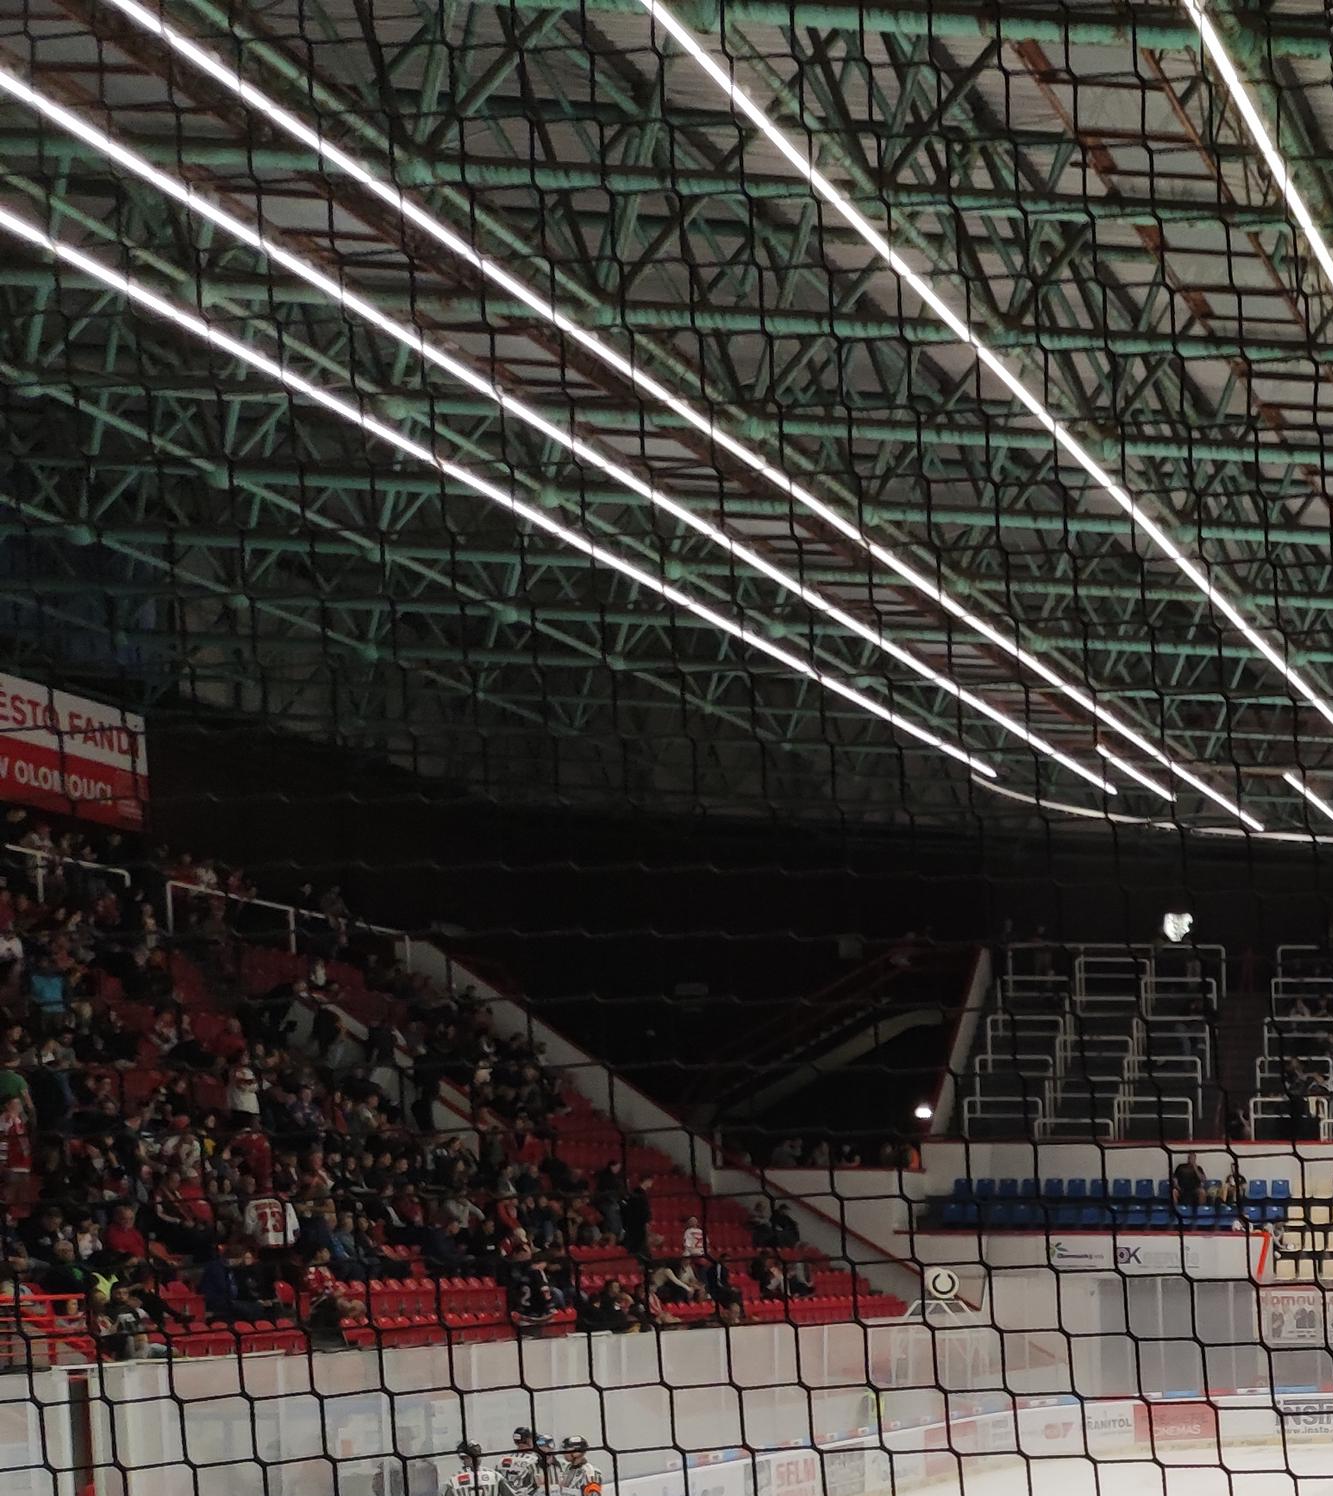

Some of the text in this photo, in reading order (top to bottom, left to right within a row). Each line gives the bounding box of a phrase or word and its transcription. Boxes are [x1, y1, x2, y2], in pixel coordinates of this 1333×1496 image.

[0, 682, 141, 760] ĚSTO FANDÍ
[14, 760, 113, 806] OLOMOUCI
[1086, 1415, 1133, 1432] RANITOL
